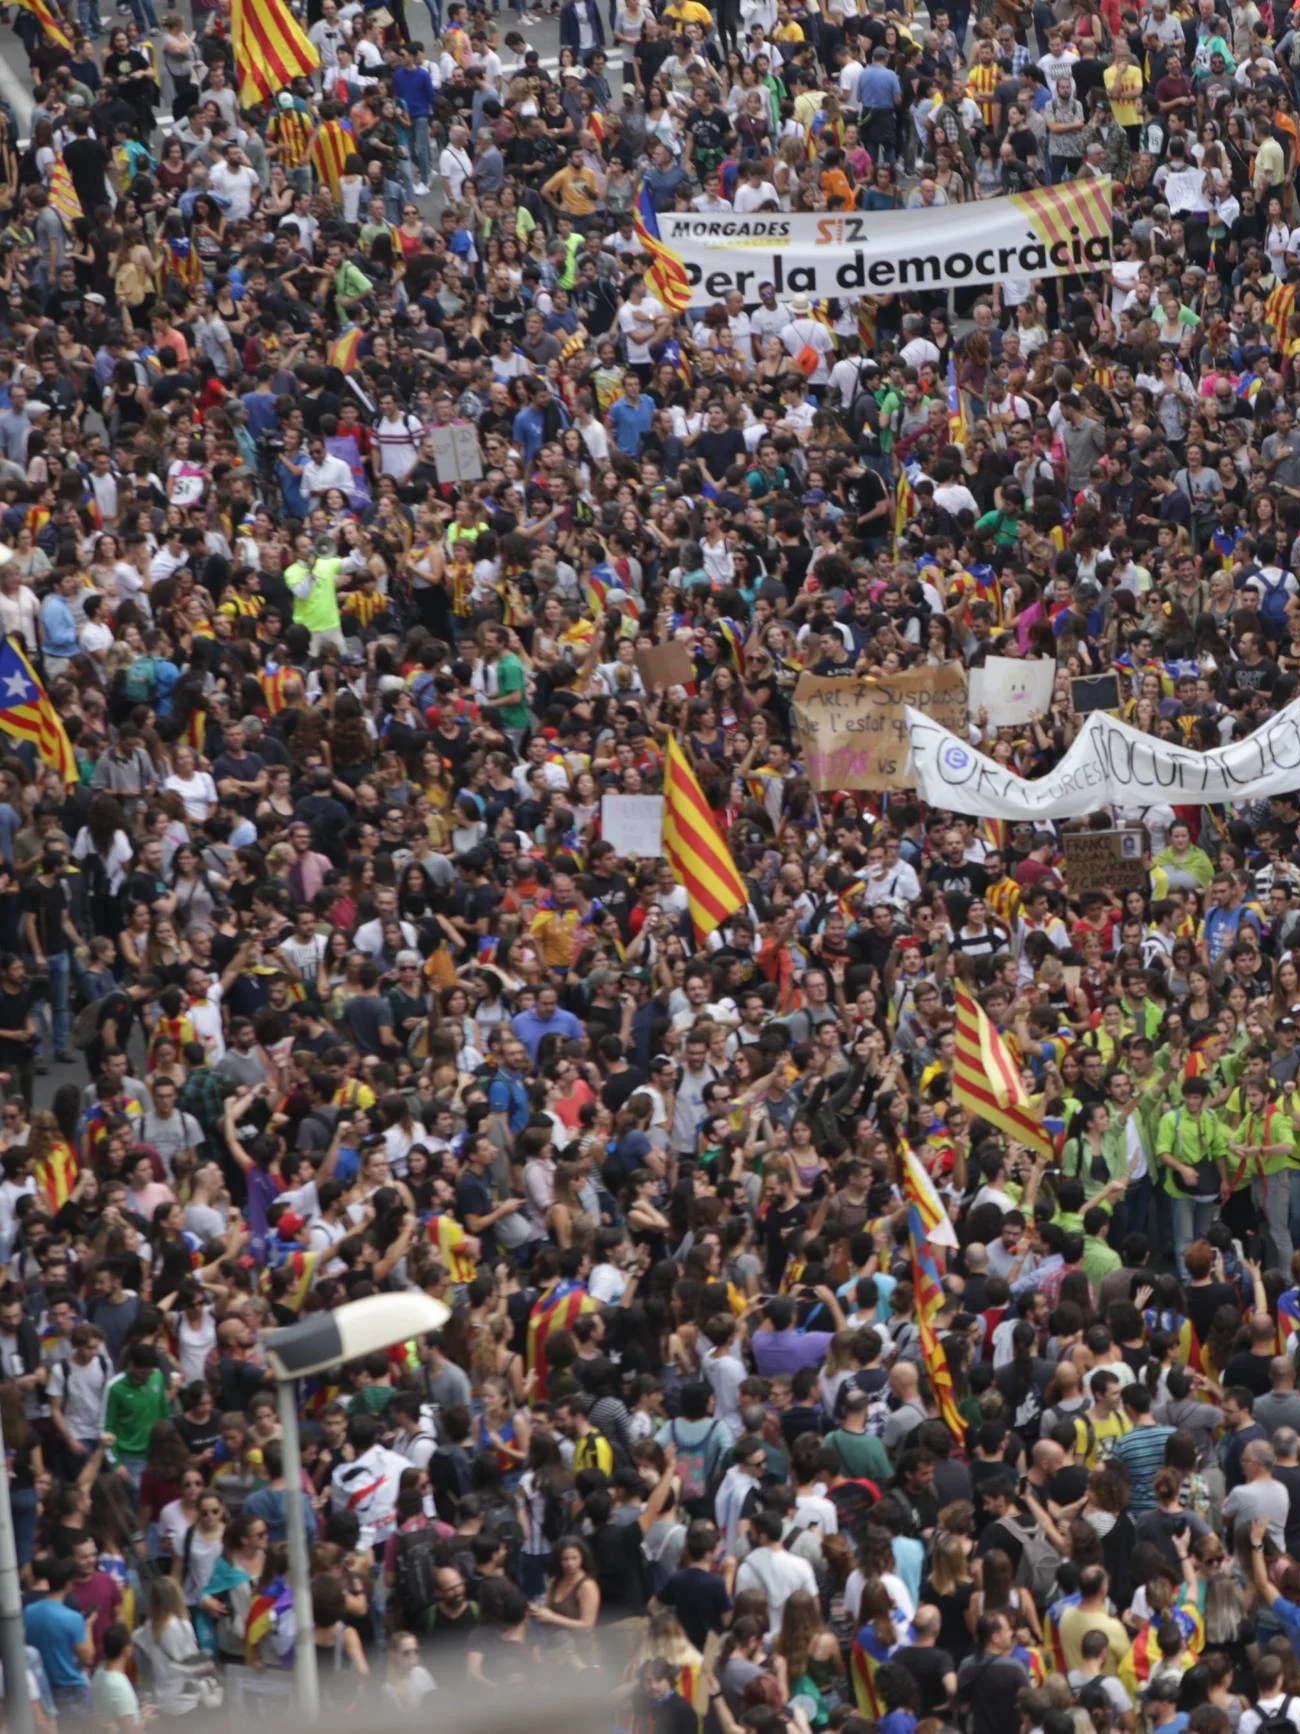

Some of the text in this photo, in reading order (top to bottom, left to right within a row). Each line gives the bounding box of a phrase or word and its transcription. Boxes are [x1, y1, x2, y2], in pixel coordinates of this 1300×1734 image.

[671, 221, 790, 238] MORGADES
[773, 254, 816, 294] la
[836, 225, 1110, 289] democràcia
